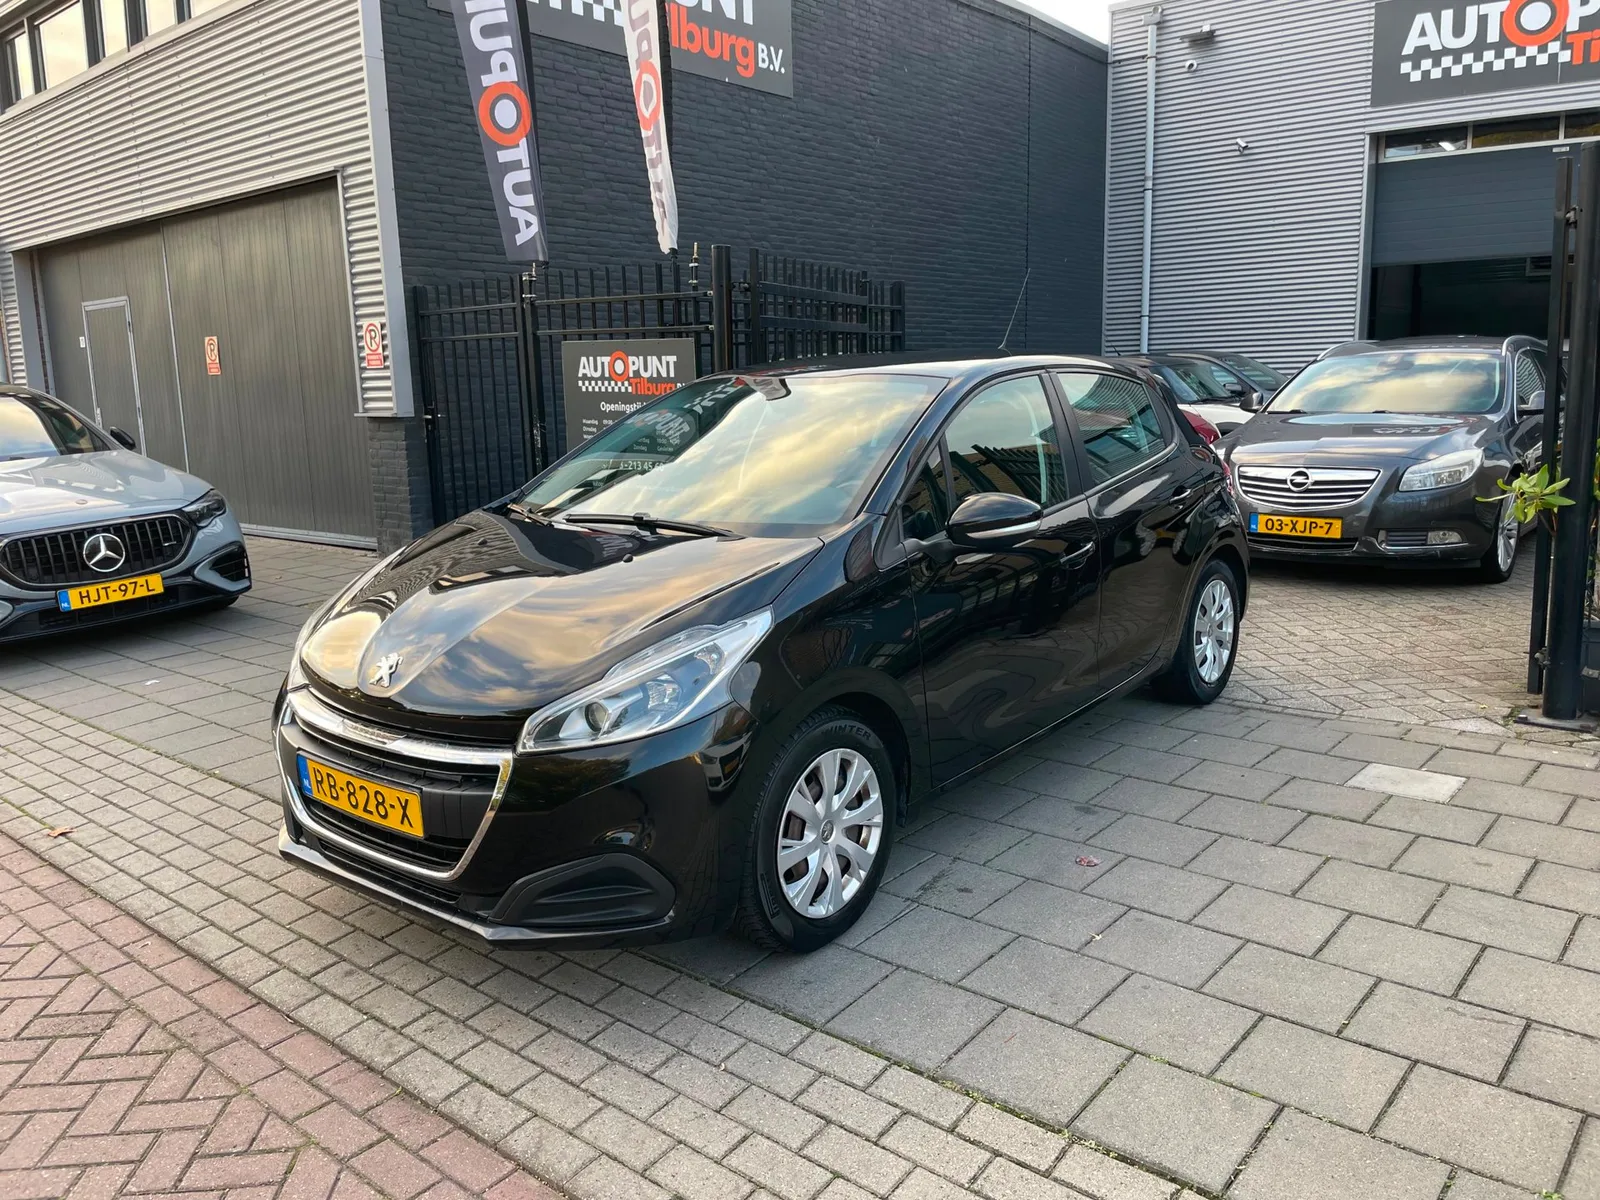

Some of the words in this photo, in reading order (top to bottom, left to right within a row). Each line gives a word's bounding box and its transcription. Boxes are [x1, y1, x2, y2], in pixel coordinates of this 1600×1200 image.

[758, 42, 786, 74] B.V.
[578, 351, 677, 382] AUTOPUNT
[1265, 518, 1333, 535] 03-XJP-7
[79, 579, 156, 605] HJT-97-L
[312, 766, 414, 828] RB-828-X
